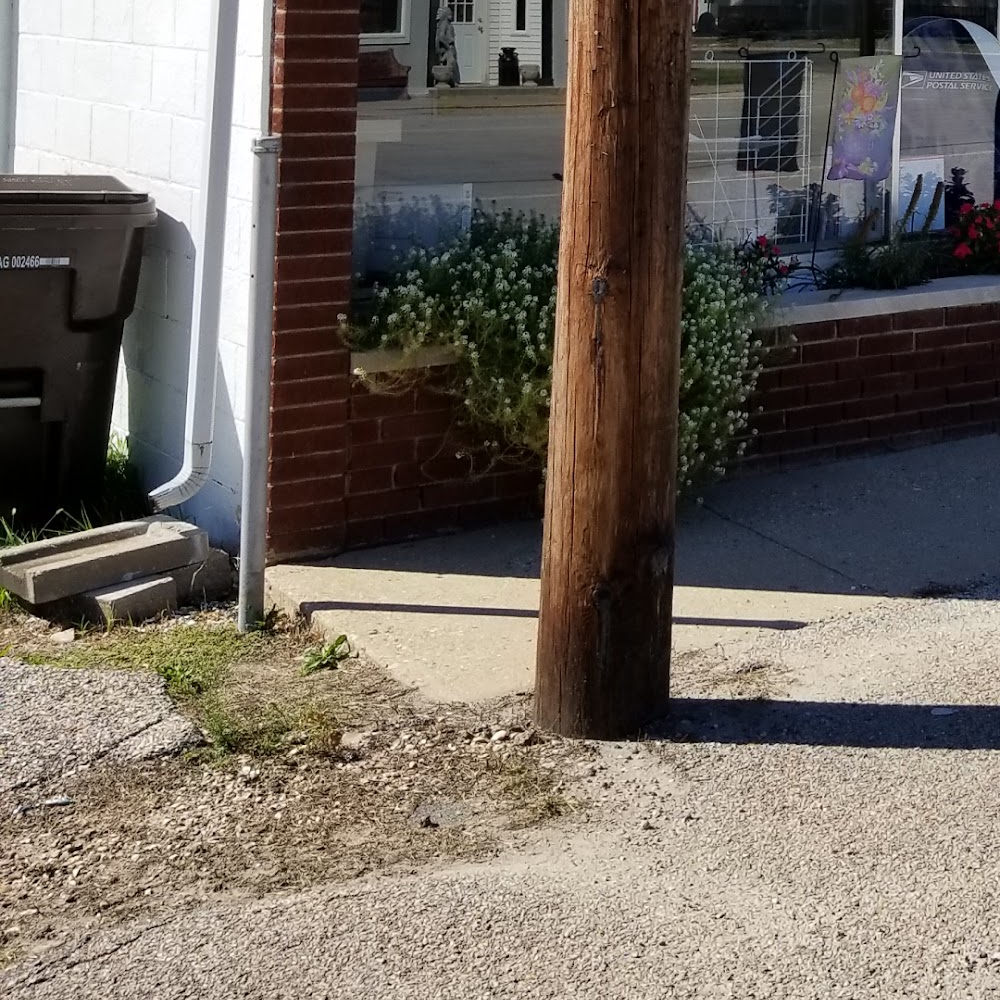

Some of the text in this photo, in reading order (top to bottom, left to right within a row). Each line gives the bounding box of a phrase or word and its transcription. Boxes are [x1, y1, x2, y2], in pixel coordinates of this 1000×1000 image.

[928, 71, 991, 82] UNITED STATES
[926, 81, 993, 92] POSTAL SERVICE
[11, 255, 40, 268] 002466
